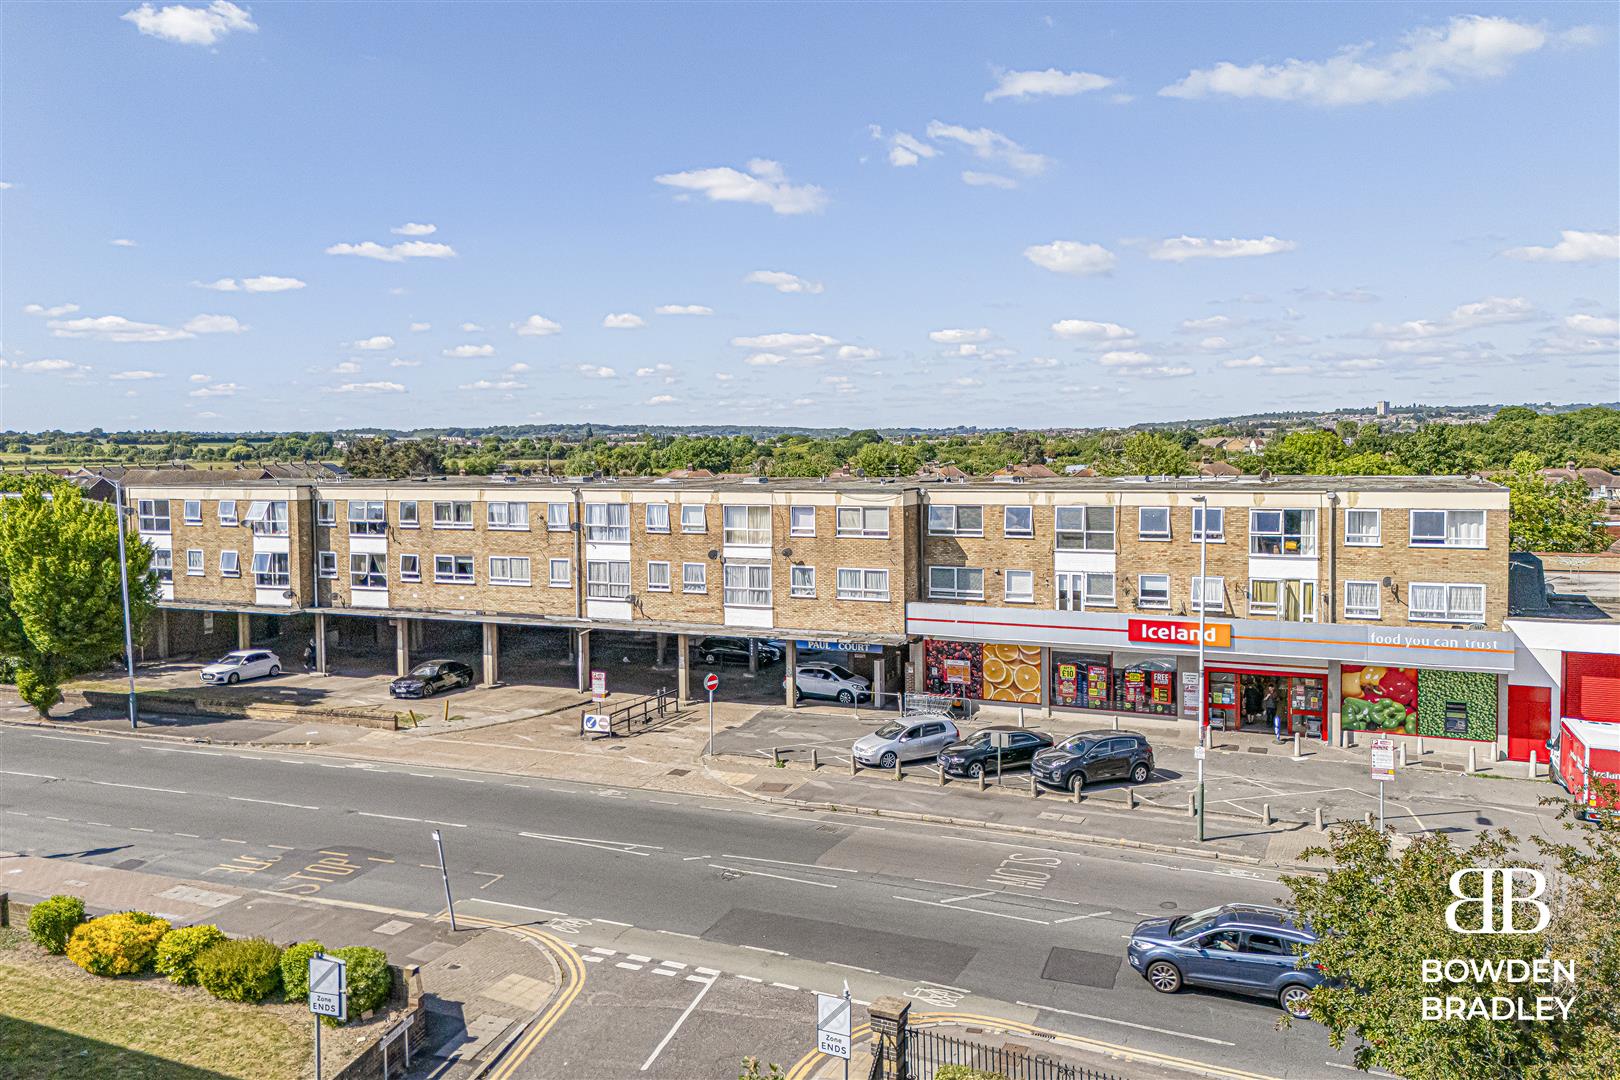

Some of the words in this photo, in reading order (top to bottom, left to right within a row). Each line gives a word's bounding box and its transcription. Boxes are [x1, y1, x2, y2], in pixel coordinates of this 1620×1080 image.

[1141, 623, 1216, 642] Iceland
[807, 640, 832, 650] PAUL
[837, 642, 871, 652] COURT
[1370, 631, 1401, 645] food
[1405, 638, 1430, 648] you
[1433, 638, 1459, 648] can
[1465, 639, 1498, 650] trust
[1061, 669, 1074, 678] £10
[1153, 672, 1169, 681] FREE
[275, 857, 362, 895] STOP
[986, 853, 1062, 890] SLOW
[316, 995, 332, 1003] Zone
[312, 1002, 336, 1013] ENDS
[825, 1034, 843, 1045] Zone
[821, 1041, 847, 1055] ENDS
